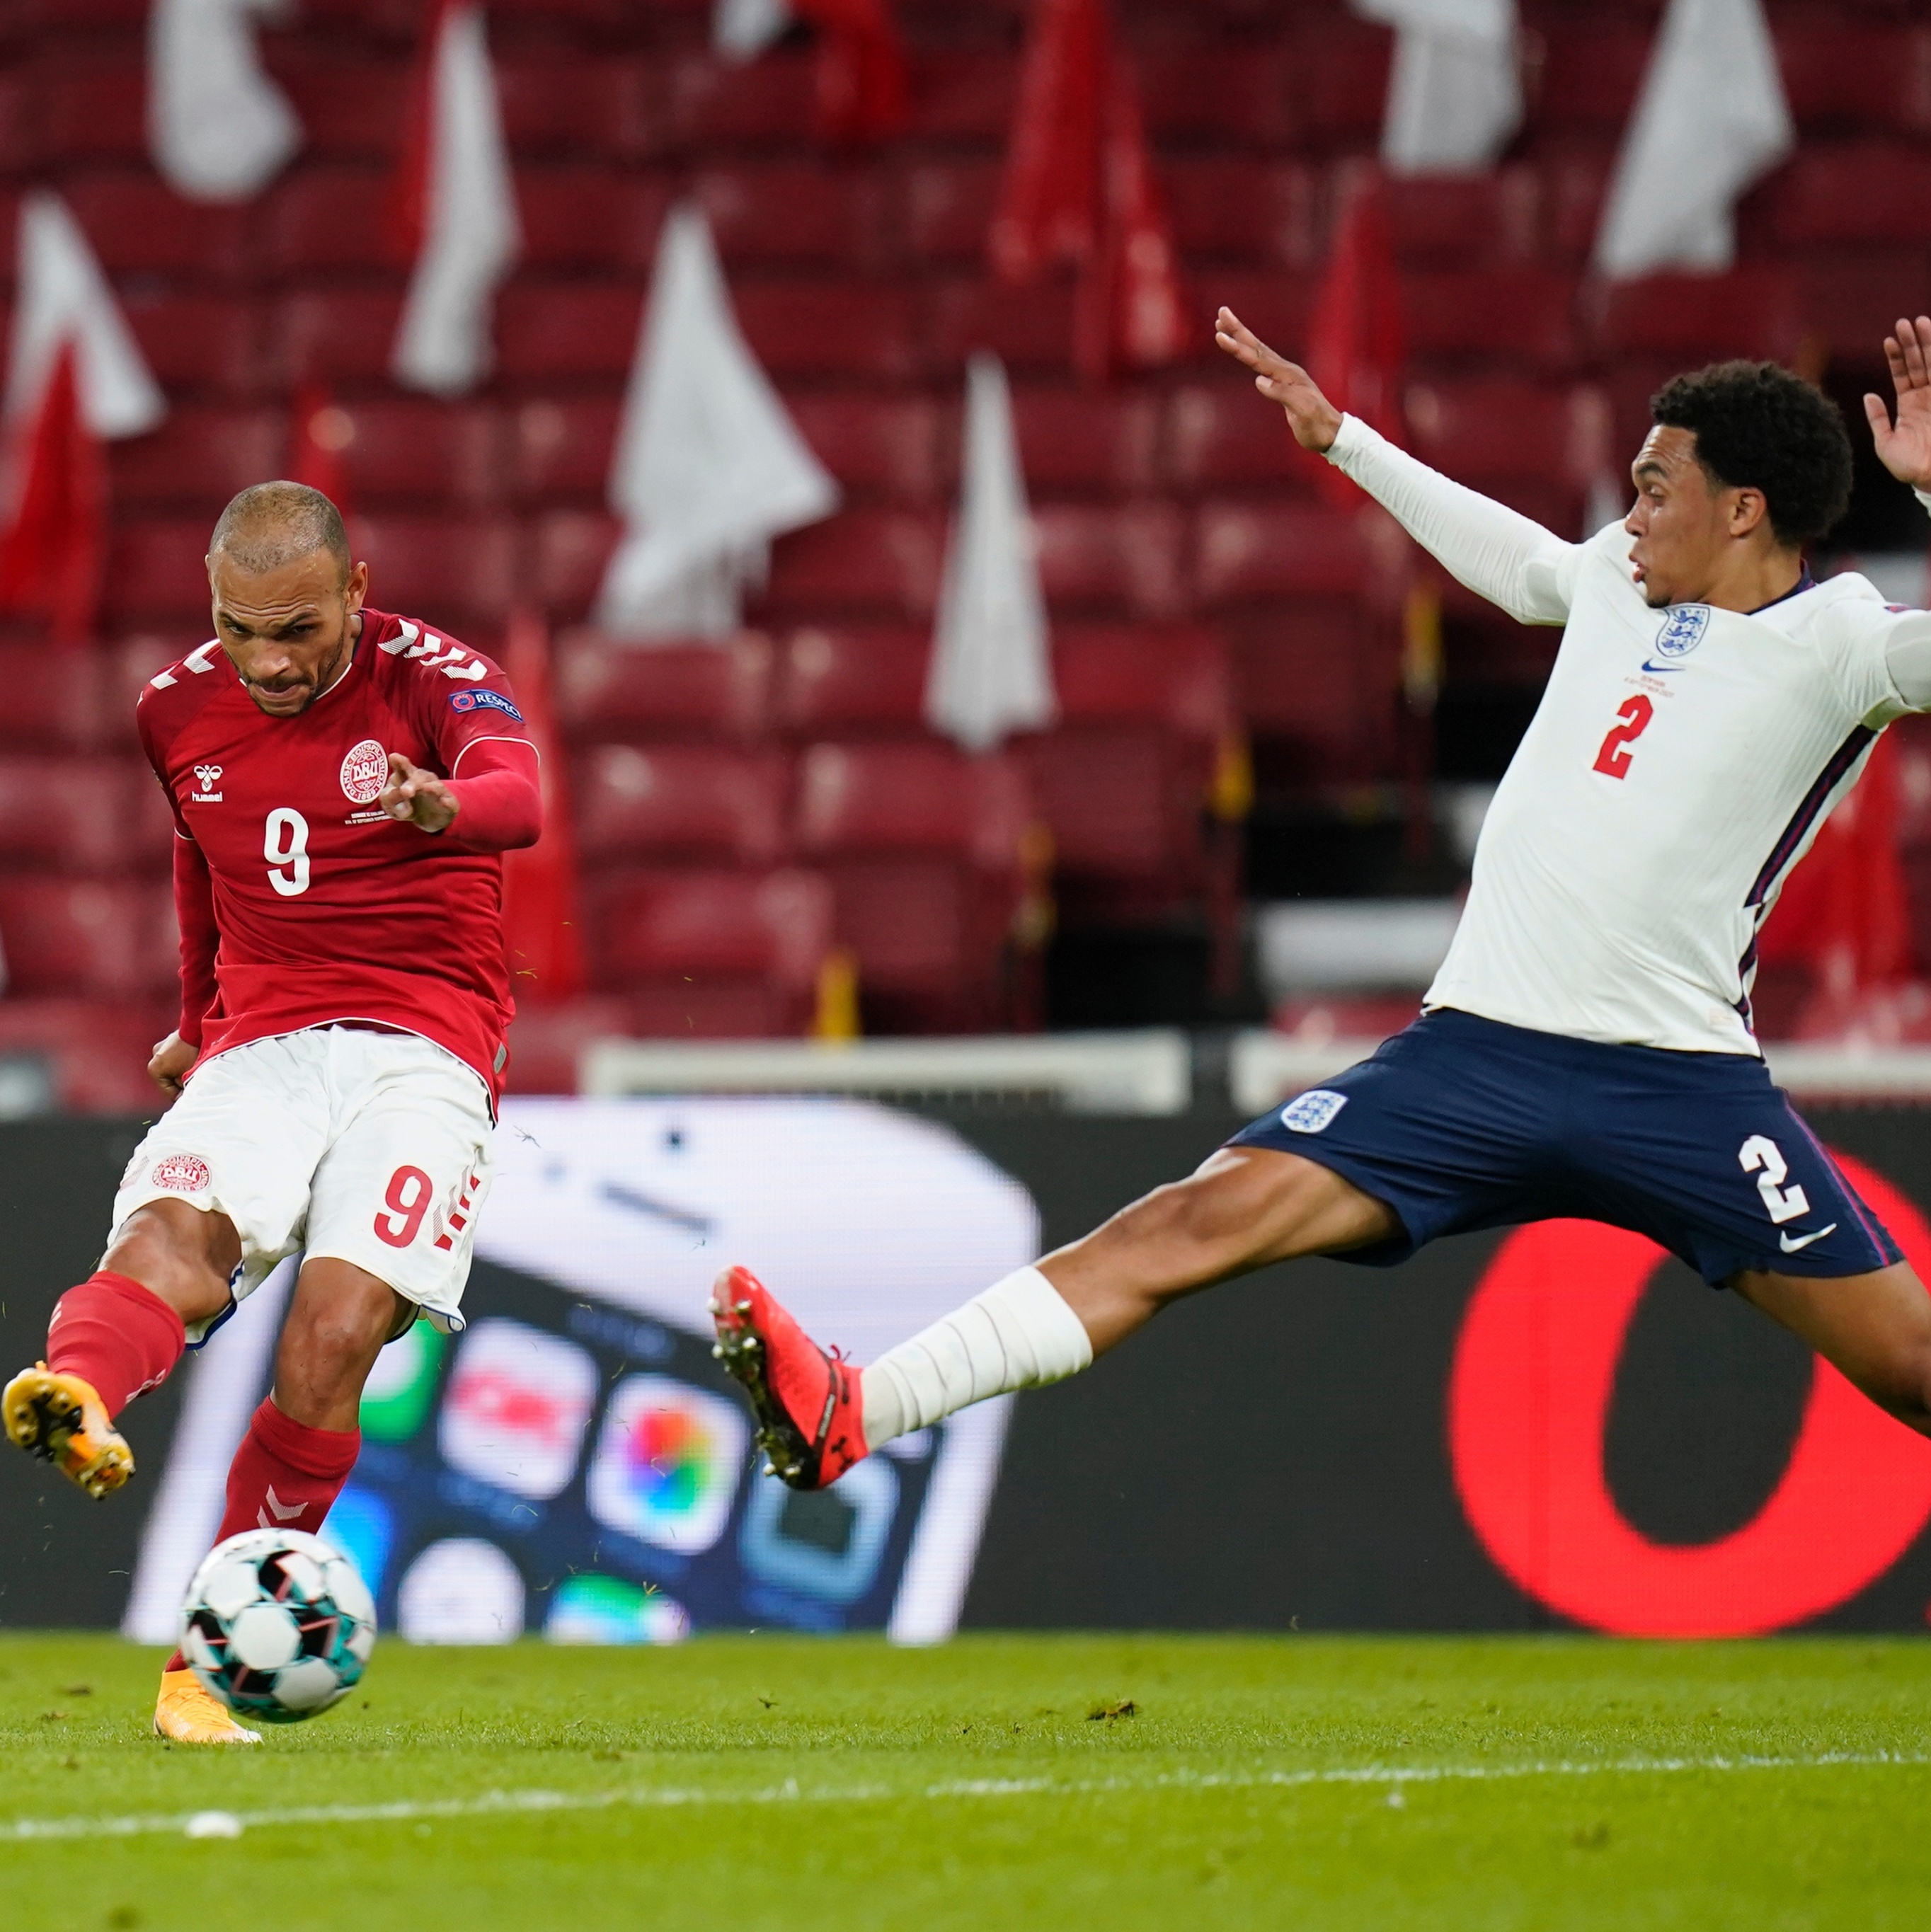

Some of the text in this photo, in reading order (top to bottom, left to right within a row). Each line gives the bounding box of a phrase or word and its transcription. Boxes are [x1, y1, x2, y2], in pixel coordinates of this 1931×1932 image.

[353, 760, 379, 782] DBU
[1593, 695, 1653, 779] 2
[191, 790, 223, 802] hummel
[264, 808, 310, 896] 9
[162, 1166, 197, 1183] DBU
[374, 1166, 432, 1248] 9
[1739, 1135, 1809, 1223] 2
